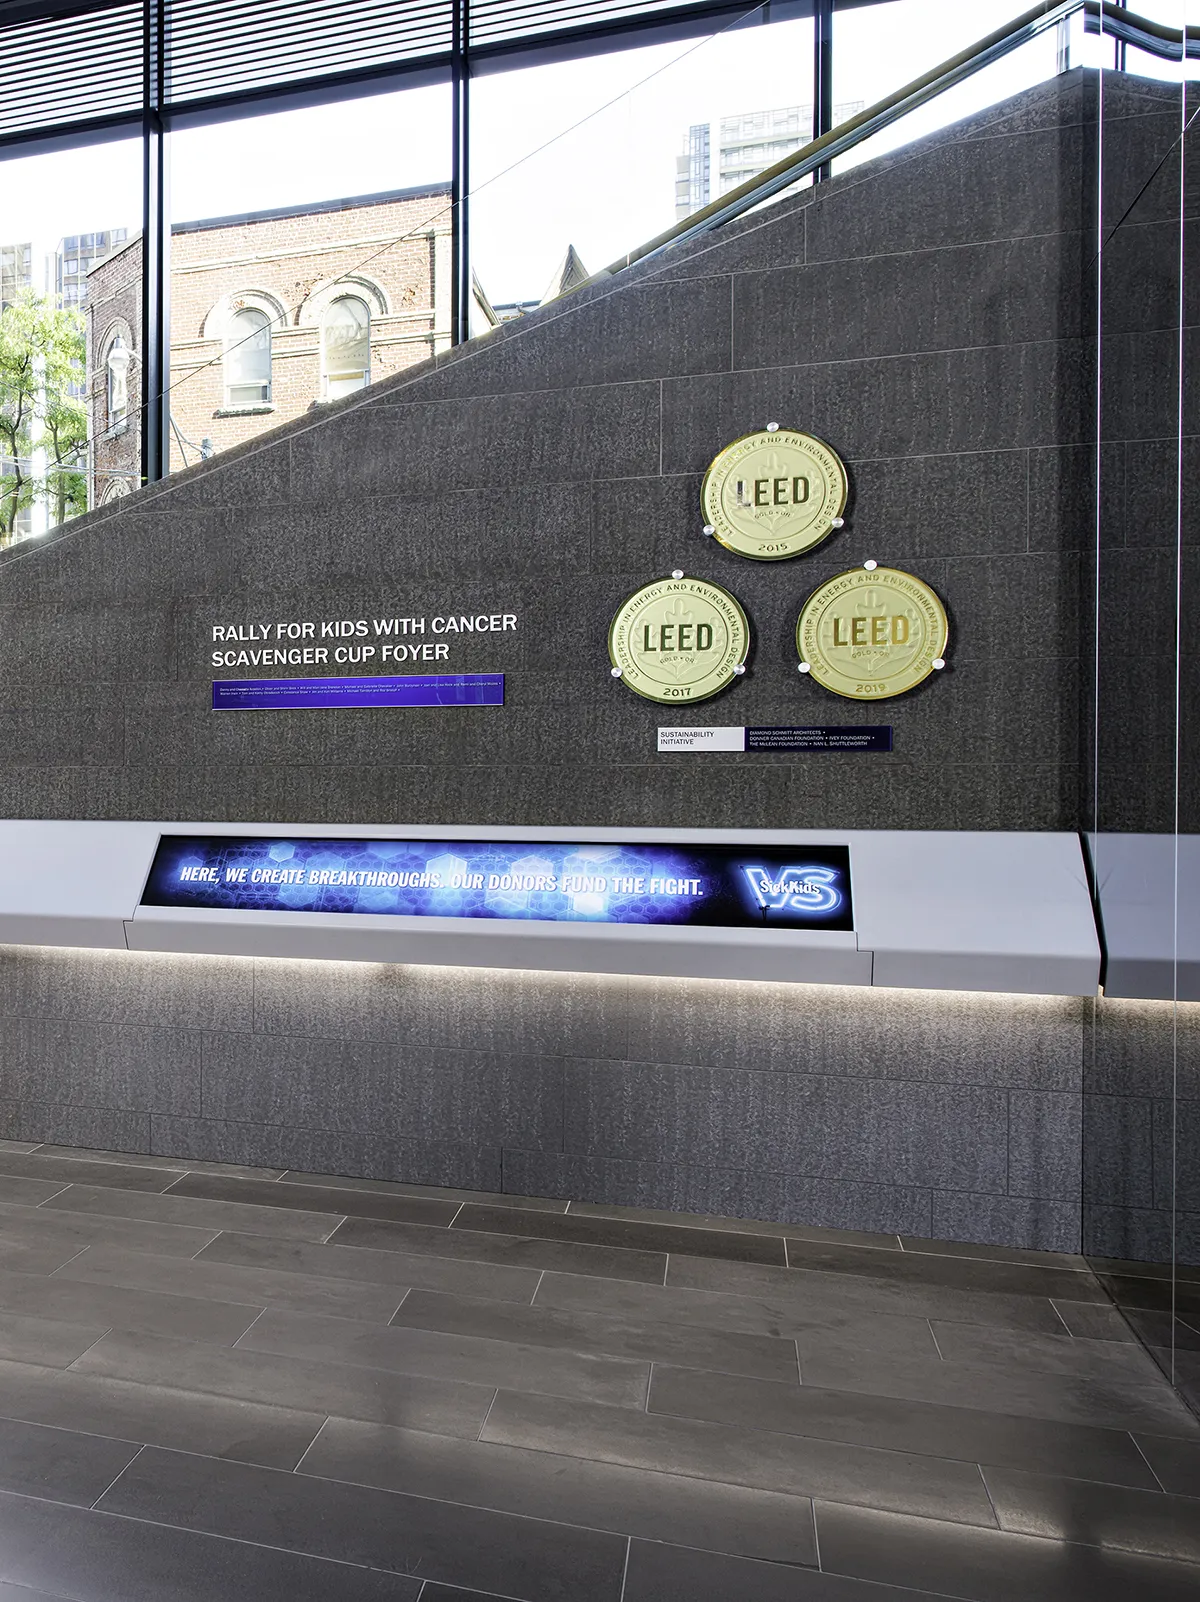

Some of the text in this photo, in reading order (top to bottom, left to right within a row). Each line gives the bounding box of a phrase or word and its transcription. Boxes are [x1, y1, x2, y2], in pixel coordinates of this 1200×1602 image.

[710, 483, 733, 537] LEADERSHIP
[785, 438, 838, 494] ENVIRONMENTAL
[814, 498, 837, 531] DESIGN
[736, 477, 810, 507] LEED
[758, 543, 788, 551] 2015
[631, 587, 662, 612] ENERGY
[212, 614, 518, 642] RALLY FOR KIDS WITH CANCER
[624, 614, 631, 622] IN
[690, 584, 739, 644] ENVIRONMENTAL
[804, 575, 938, 675] LEADERSHIP IN ENERGY AND ENVIRONMENTAL DESIGN
[644, 624, 712, 652] LEED
[834, 615, 909, 646] LEED
[212, 644, 450, 667] SCAVENGER CUP FOYER
[618, 626, 638, 679] LEADERSHIP
[660, 656, 679, 664] GOLD
[716, 647, 738, 678] DESIGN
[663, 688, 691, 696] 2017
[856, 684, 886, 693] 2019
[180, 867, 704, 896] HERE, WE CREATE BREAKTHROUGHS. OUR DONORS FUND THE FIGHT.
[745, 868, 837, 911] VS
[760, 880, 820, 894] SickKids
